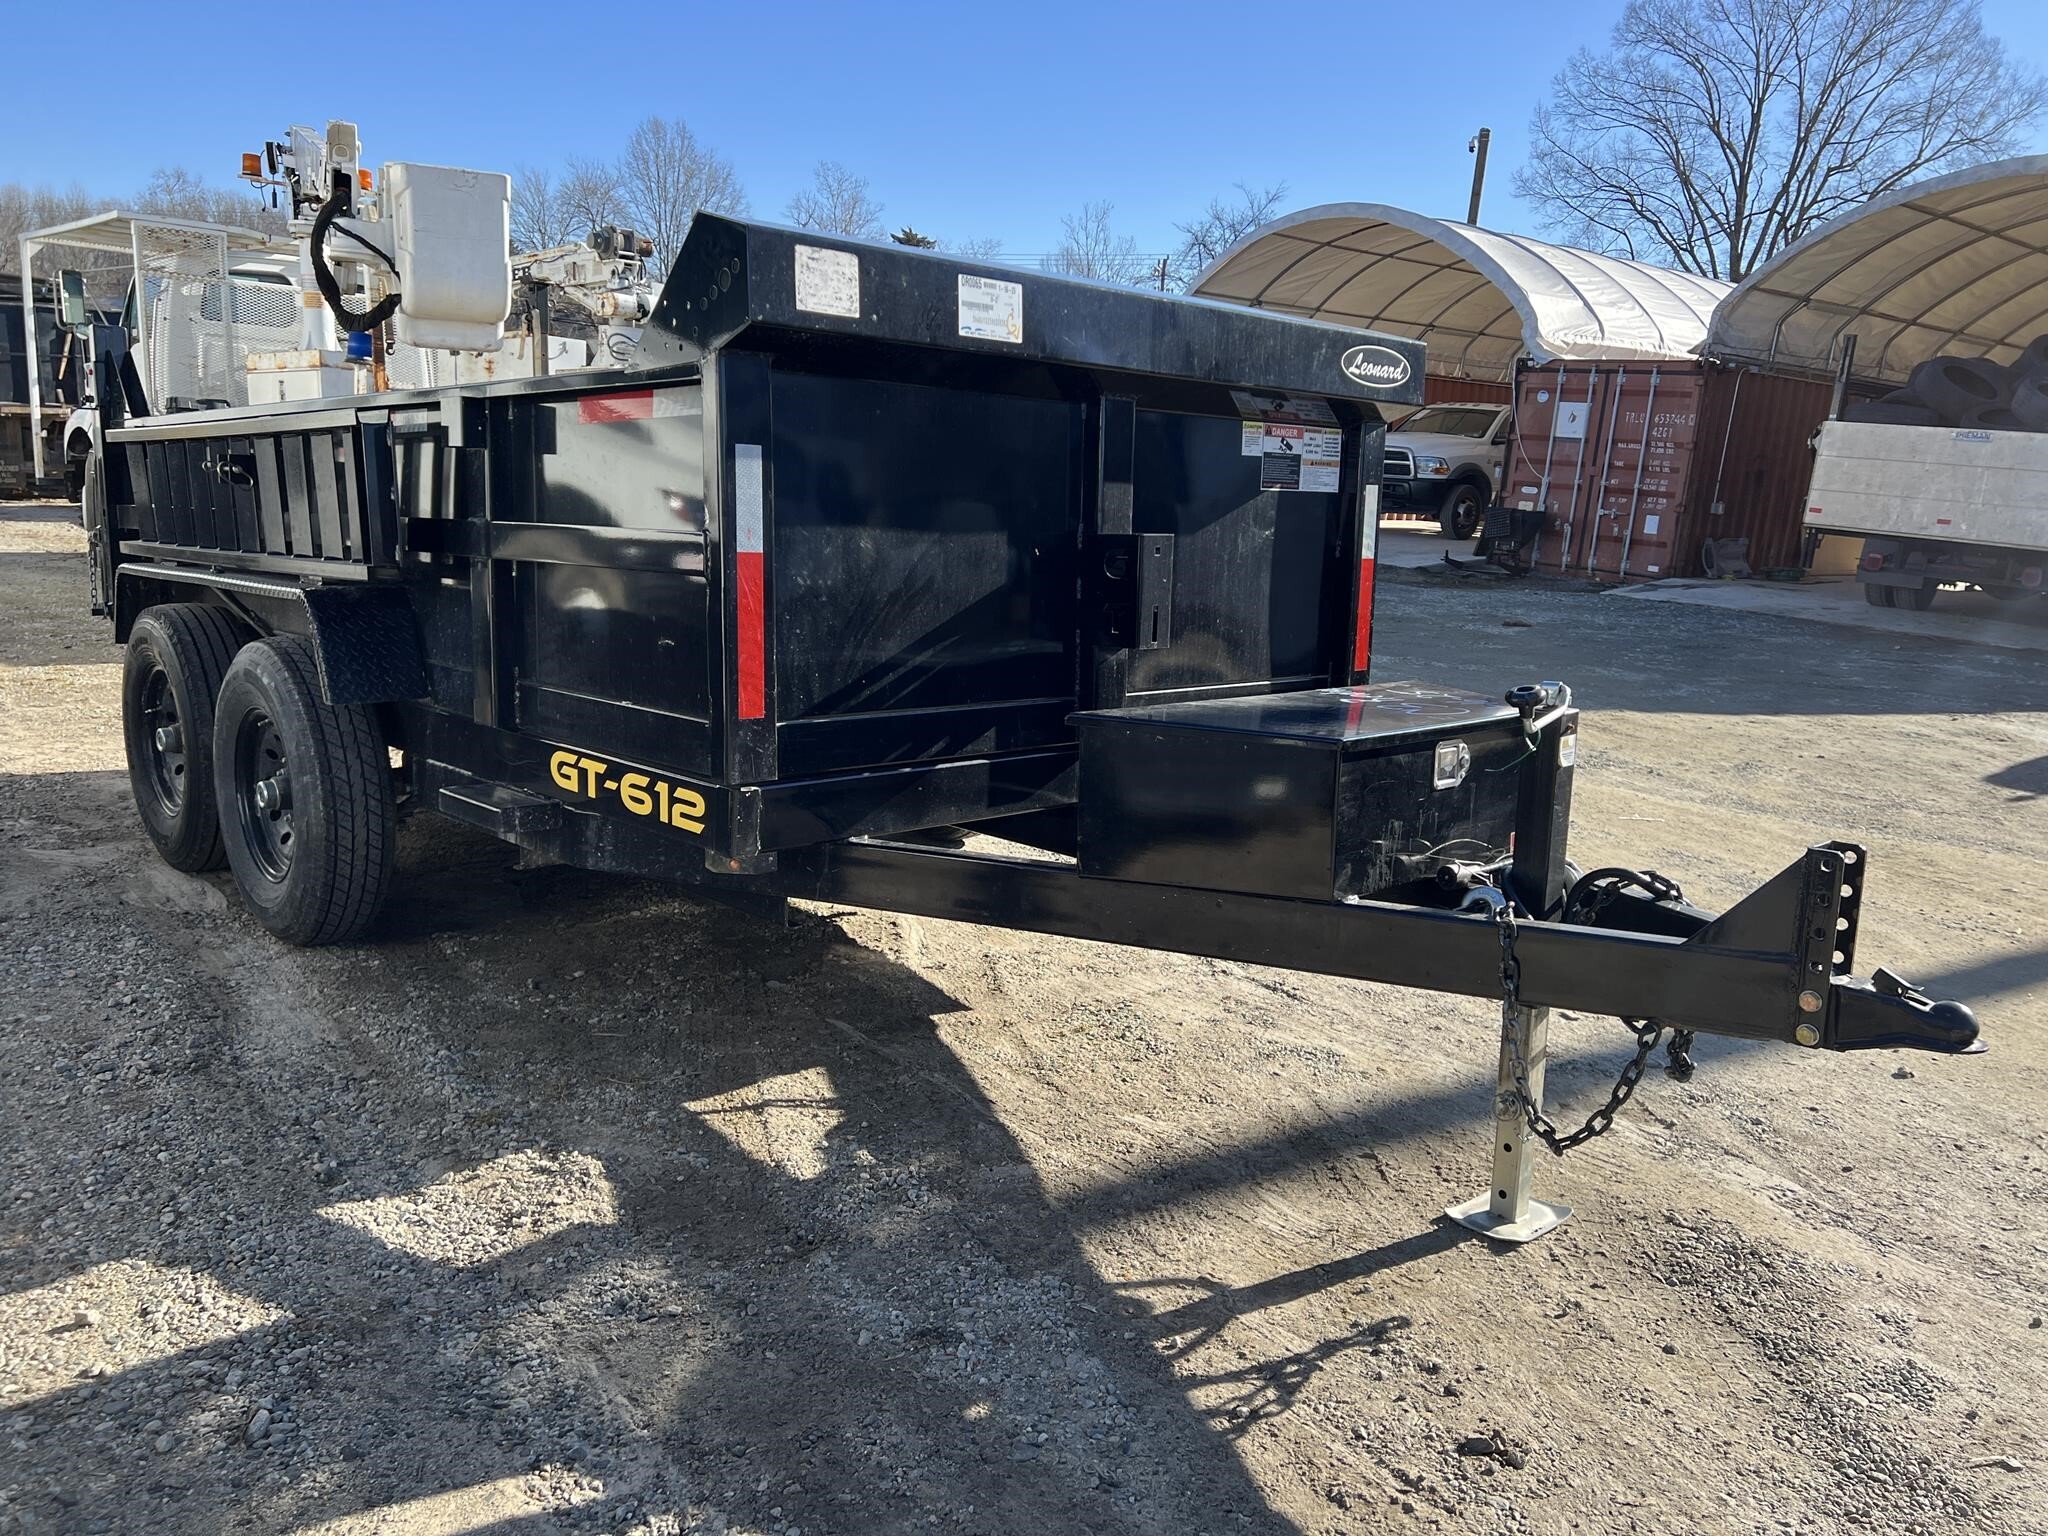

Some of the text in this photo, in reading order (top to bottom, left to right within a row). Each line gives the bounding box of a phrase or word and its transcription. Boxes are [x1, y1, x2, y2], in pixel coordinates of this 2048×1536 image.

[1348, 352, 1405, 380] Leonard
[1654, 413, 1686, 425] 653244
[1271, 427, 1298, 437] DANGER
[550, 750, 706, 835] GT-612
